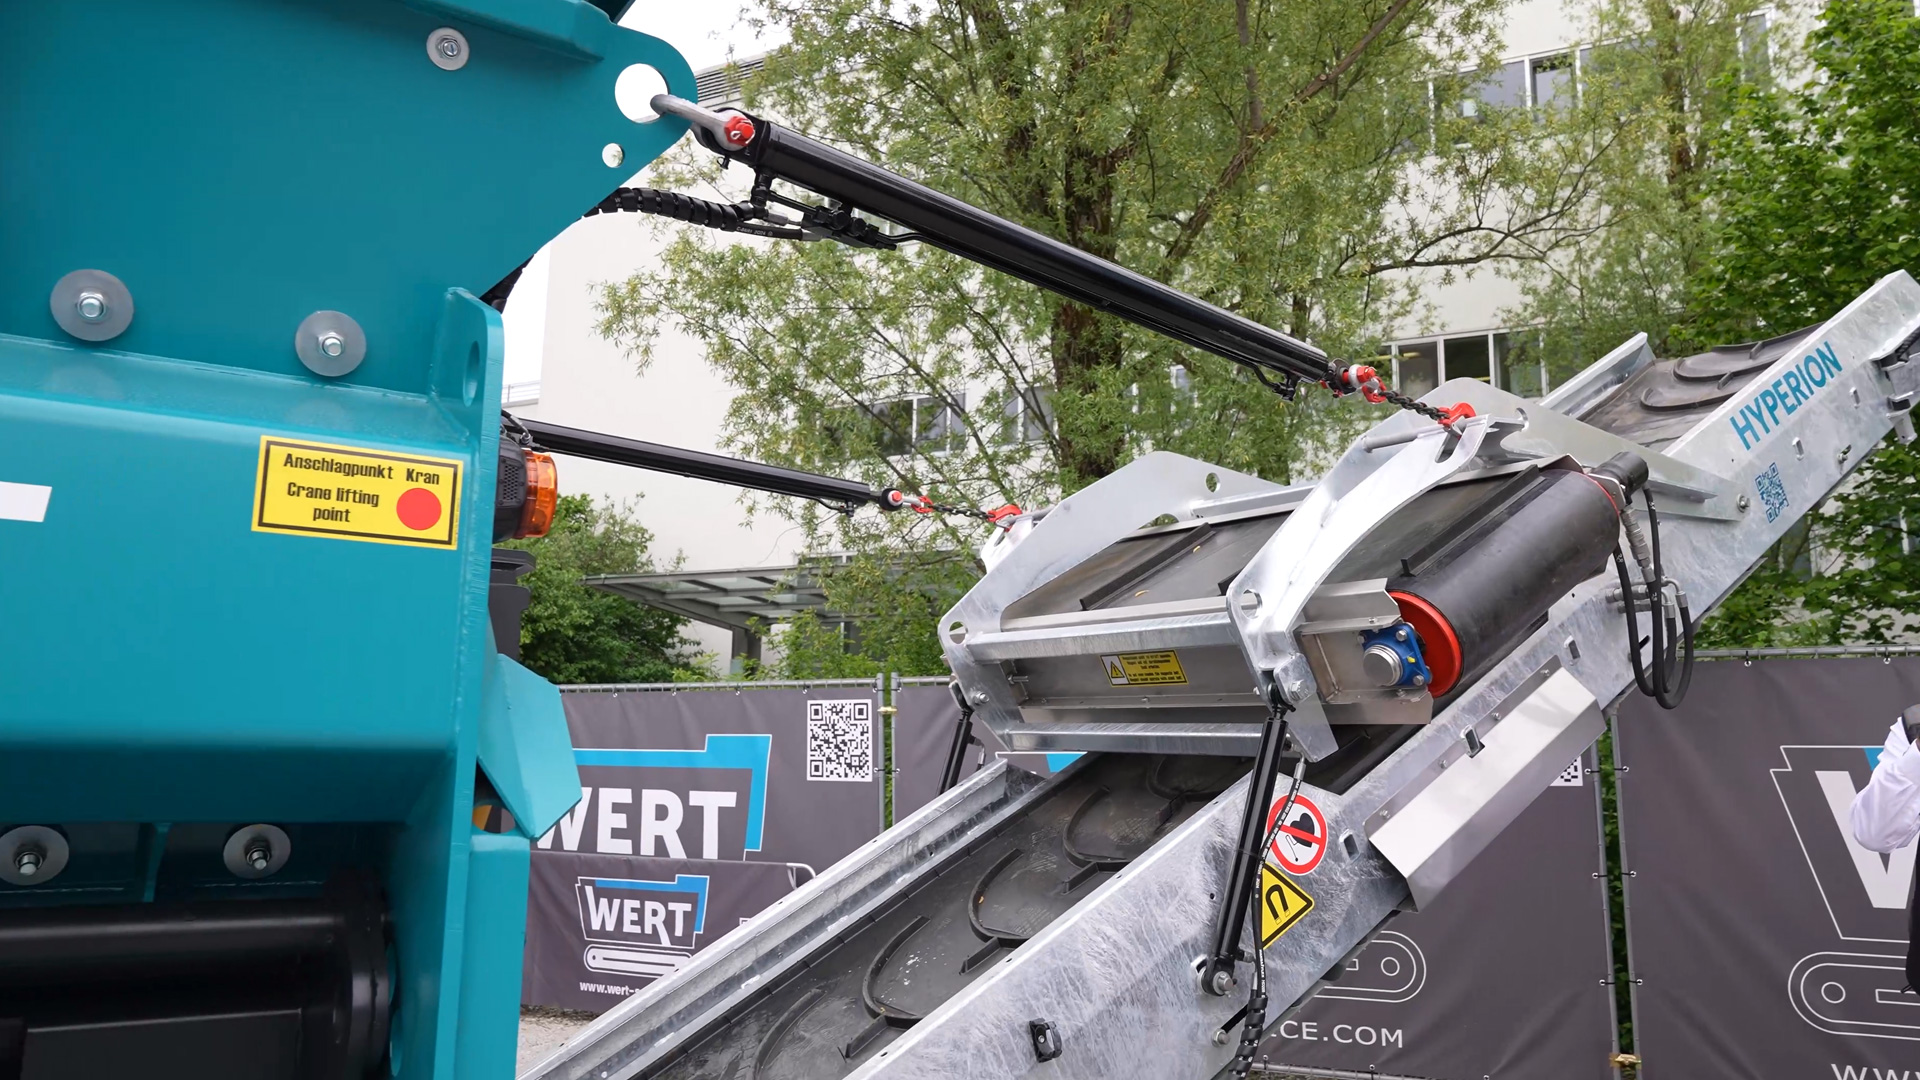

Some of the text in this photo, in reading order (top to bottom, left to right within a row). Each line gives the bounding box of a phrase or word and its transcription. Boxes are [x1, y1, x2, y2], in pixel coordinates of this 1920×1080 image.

[1729, 340, 1843, 451] HYPERION
[283, 453, 440, 485] Anschlagpunkt Kran
[287, 481, 380, 507] Crane lifting
[312, 506, 351, 523] point
[584, 885, 692, 946] WERT
[1271, 1020, 1403, 1048] CE.COM
